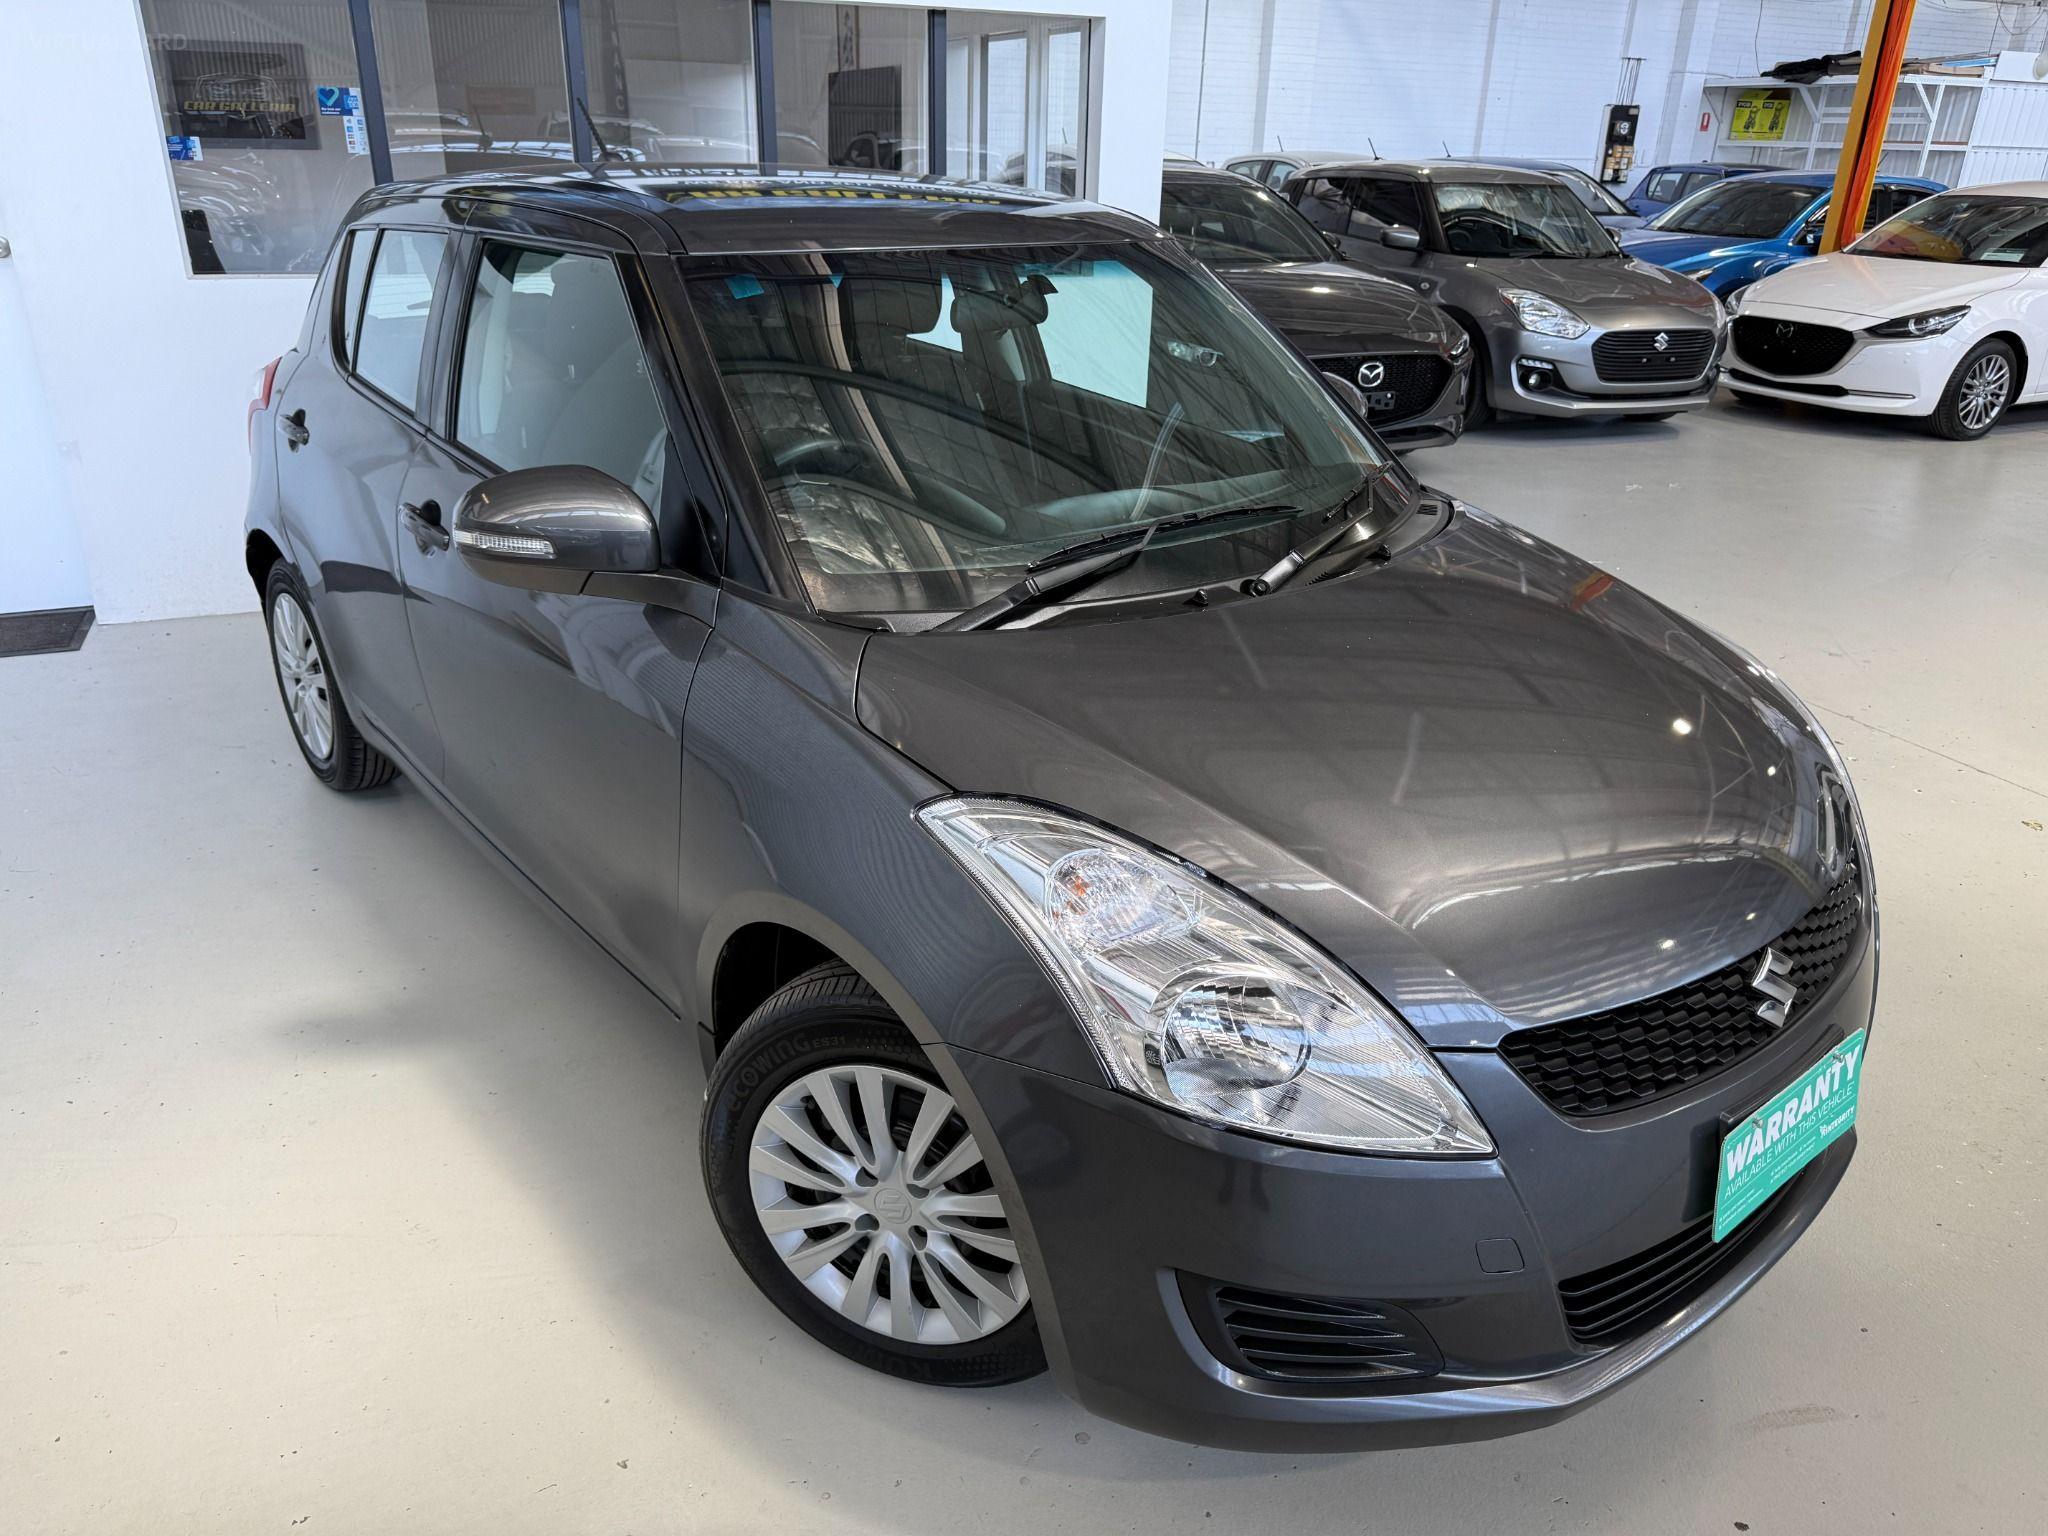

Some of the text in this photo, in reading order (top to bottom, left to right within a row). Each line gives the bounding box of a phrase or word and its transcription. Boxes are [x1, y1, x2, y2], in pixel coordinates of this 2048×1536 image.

[184, 100, 216, 111] CAR
[1724, 1146, 1774, 1200] AVAILABLE
[1775, 1128, 1797, 1156] WITH
[1798, 1111, 1817, 1133] THIS
[1818, 1081, 1855, 1119] VEHICLE
[1726, 1044, 1861, 1181] WARRANTY
